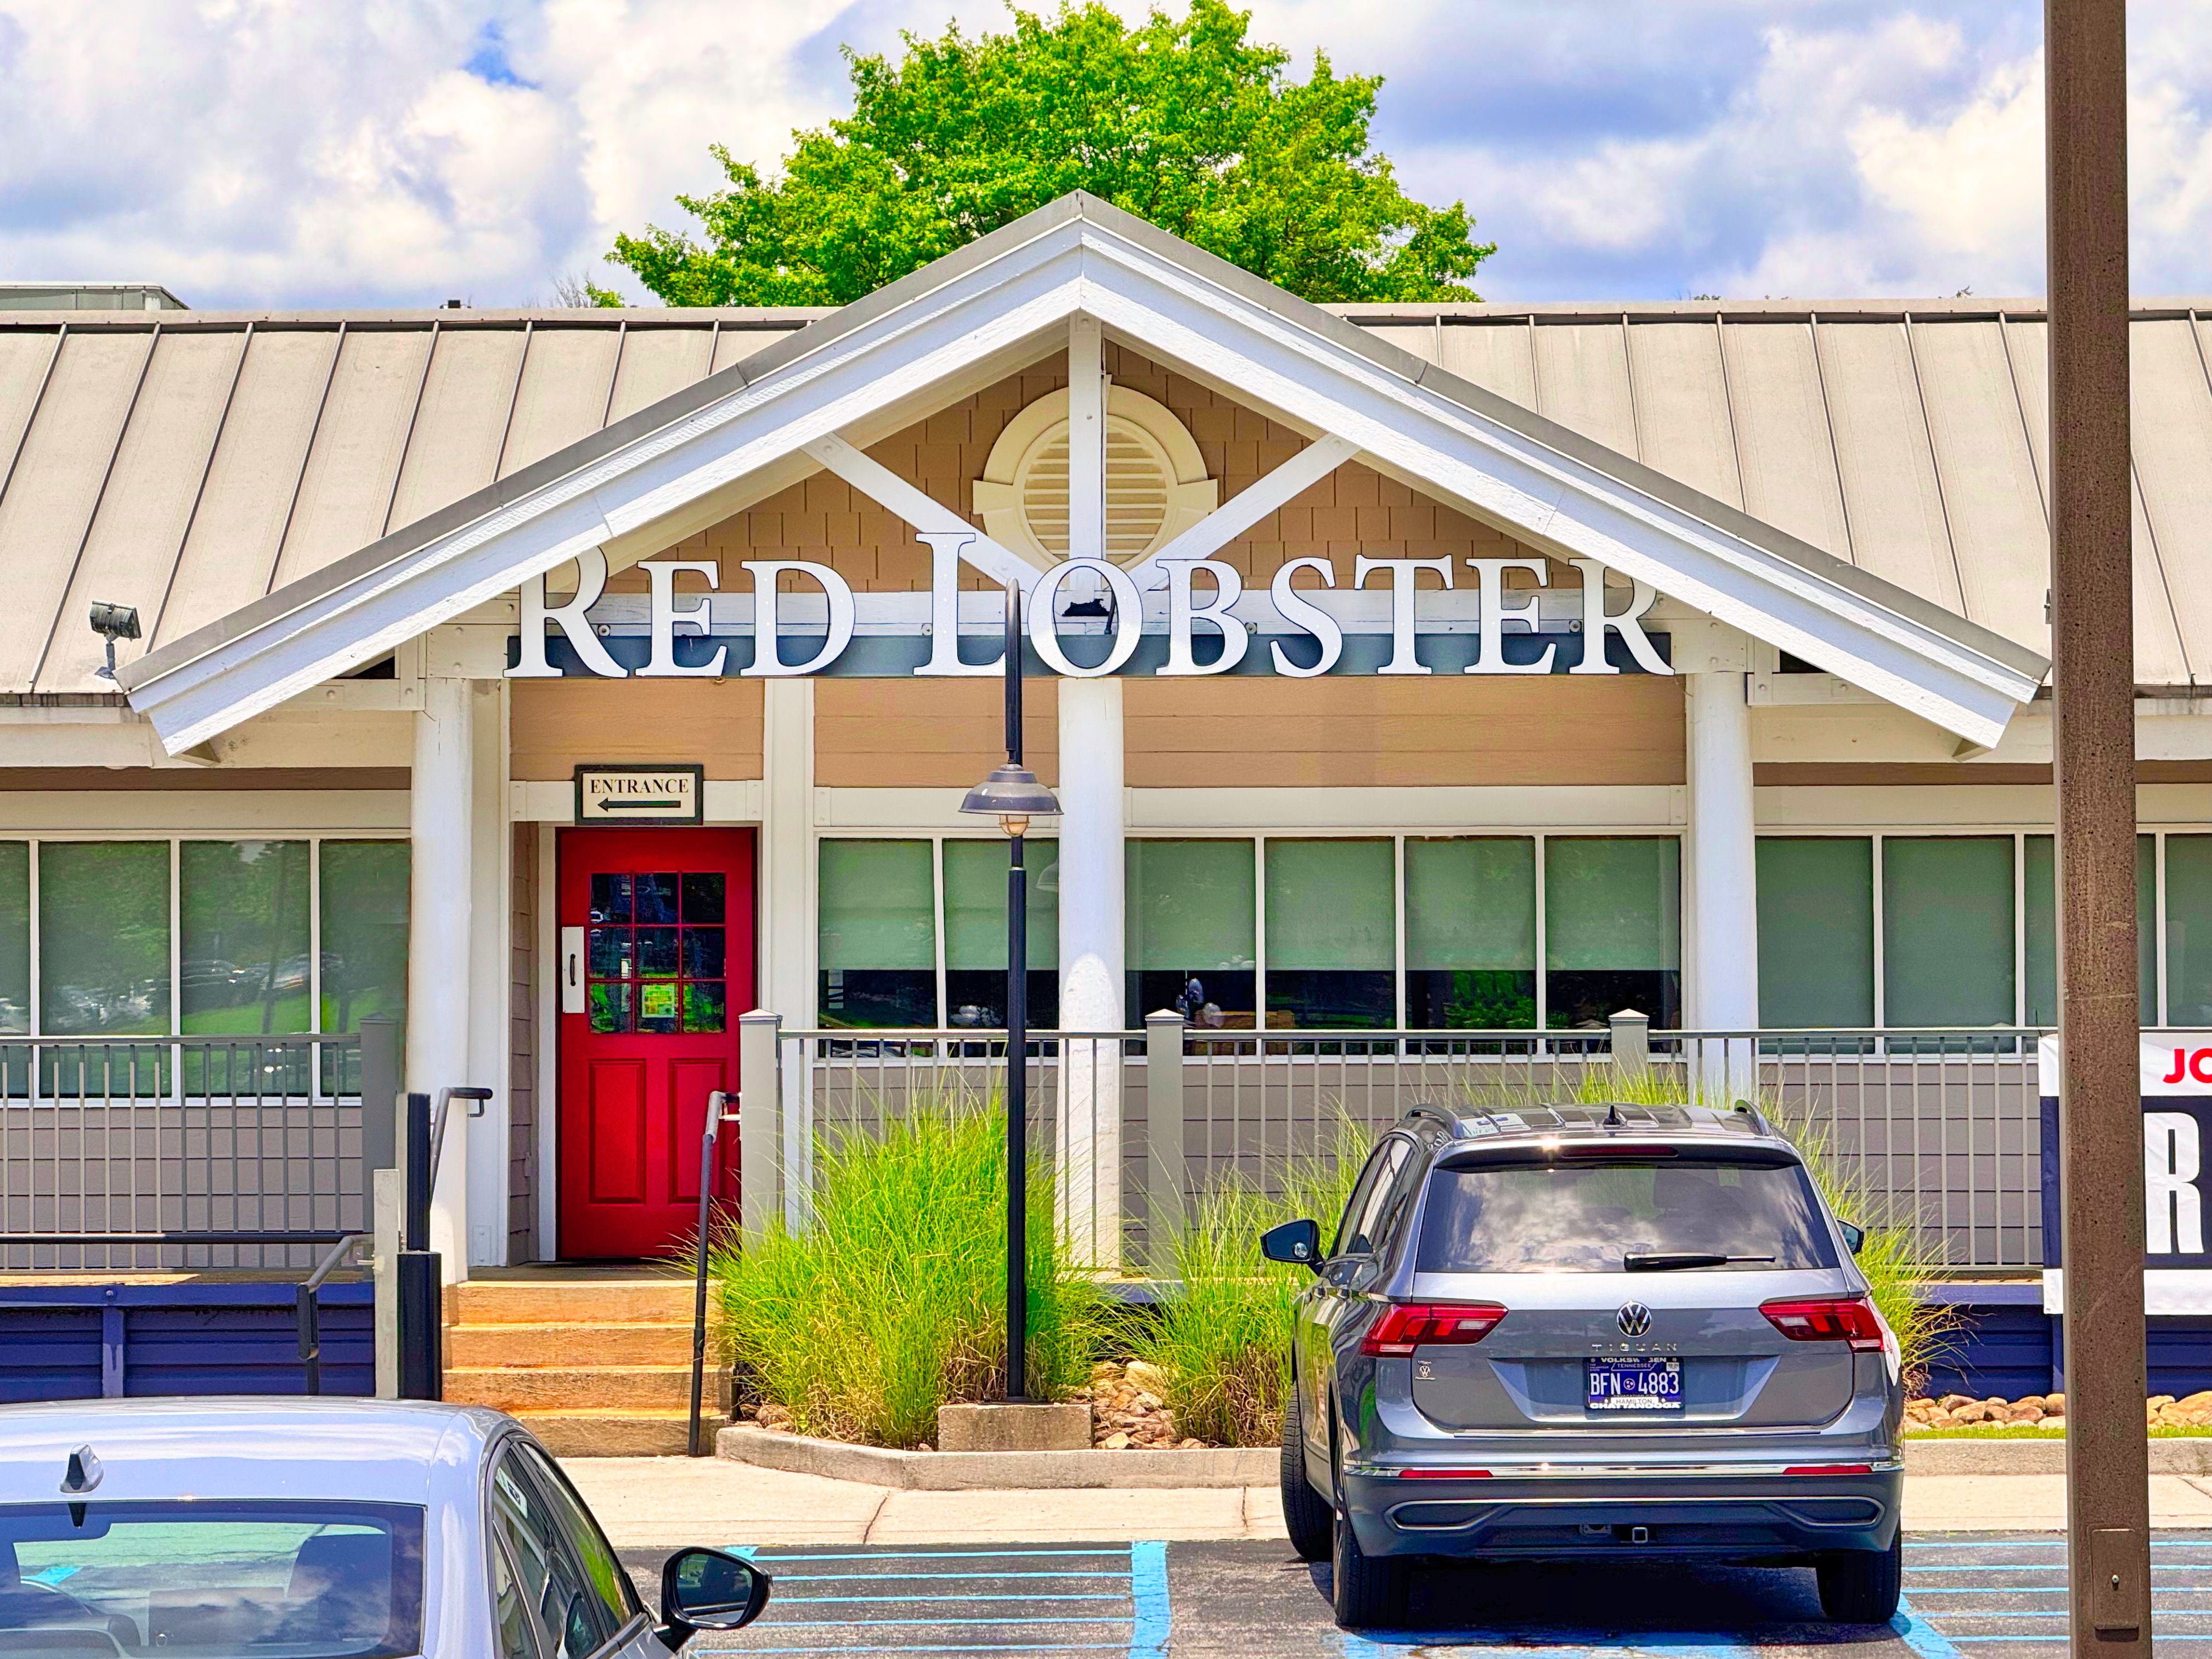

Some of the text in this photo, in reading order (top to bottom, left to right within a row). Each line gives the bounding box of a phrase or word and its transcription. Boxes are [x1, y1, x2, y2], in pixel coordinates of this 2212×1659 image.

[503, 533, 1675, 678] RED LOBSTER
[590, 778, 689, 793] ENTRANCE
[1592, 1343, 1677, 1352] TIGUAN
[1590, 1372, 1679, 1395] BFN 4883
